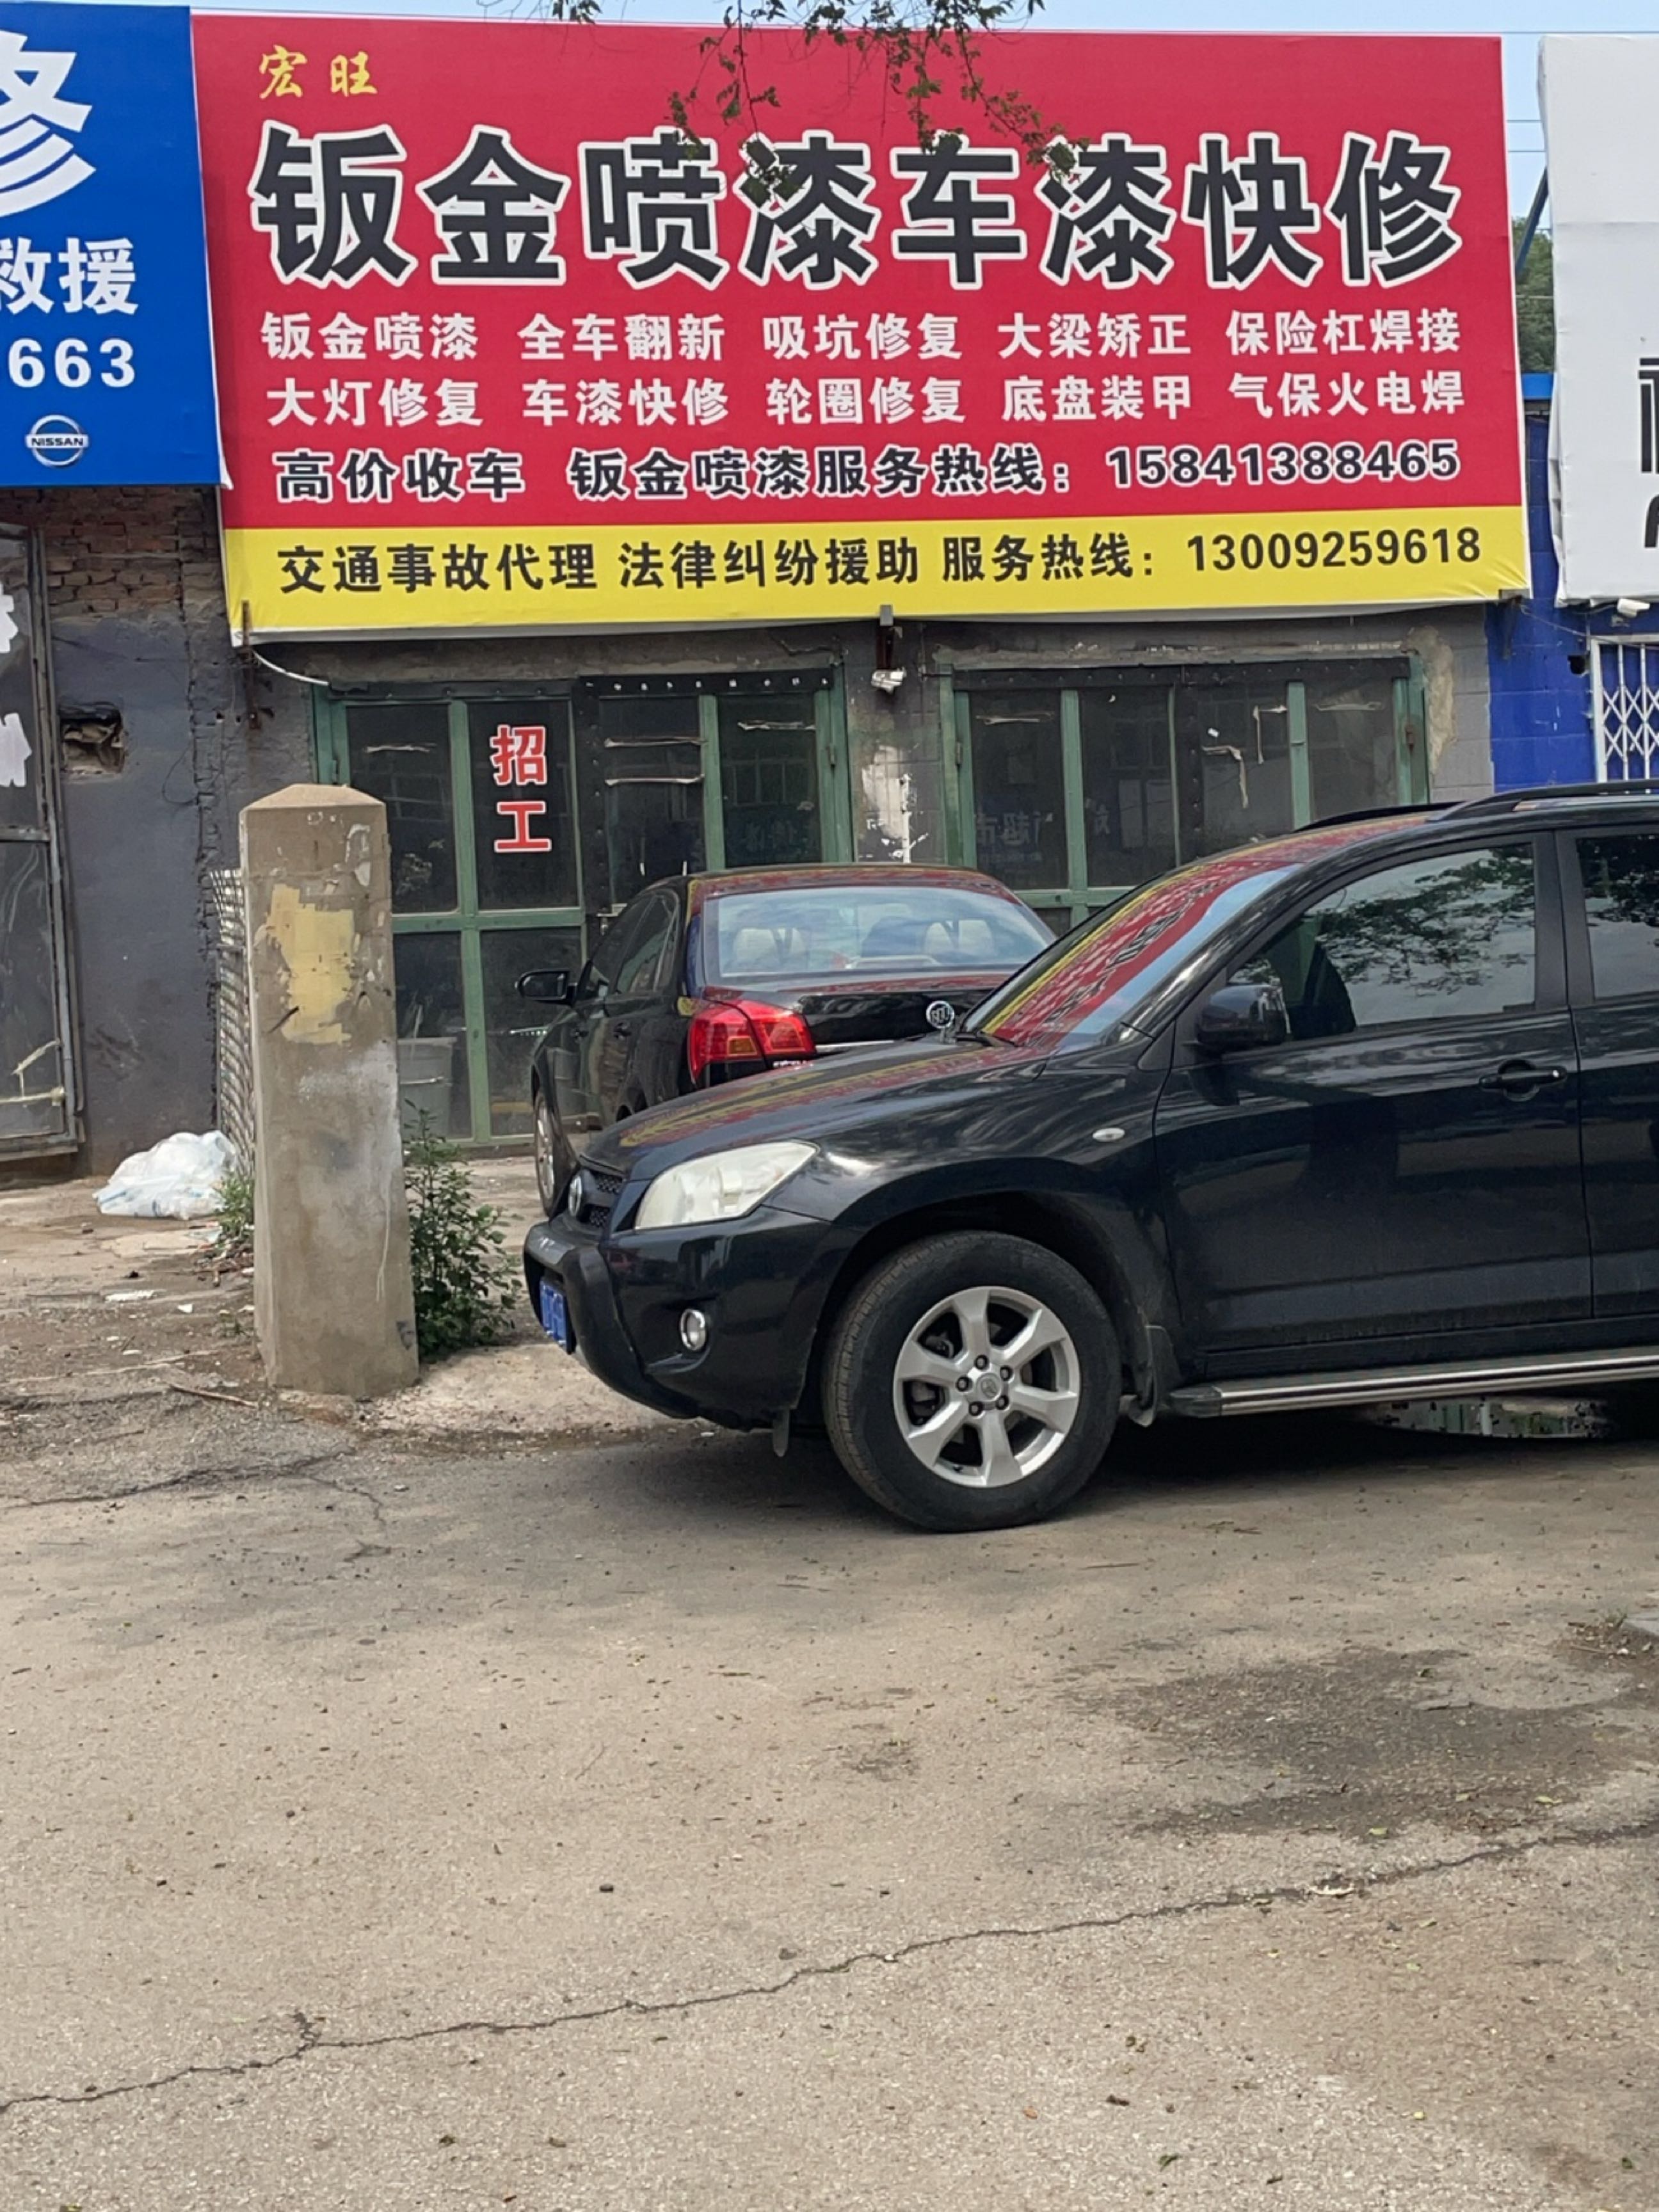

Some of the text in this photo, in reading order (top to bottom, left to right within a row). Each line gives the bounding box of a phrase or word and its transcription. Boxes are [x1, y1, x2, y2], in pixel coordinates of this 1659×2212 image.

[248, 119, 1462, 289] 钣金喷漆车漆快修
[8, 337, 135, 388] 663
[262, 308, 1460, 360] 钣金喷漆 全车翻新 吸坑修复 大梁矫正 保险杠焊接
[268, 370, 1464, 426] 大灯修复 车漆快修 轮圈修复 底盘装甲 气保火电焊
[31, 437, 84, 447] NISSAN
[273, 447, 526, 503] 高价收车
[1106, 438, 1461, 488] 15841388465
[278, 544, 597, 593] 交通事故代理
[619, 538, 917, 589] 法律纠纷援助
[1188, 528, 1479, 570] 13009259618
[490, 724, 552, 853] 招工
